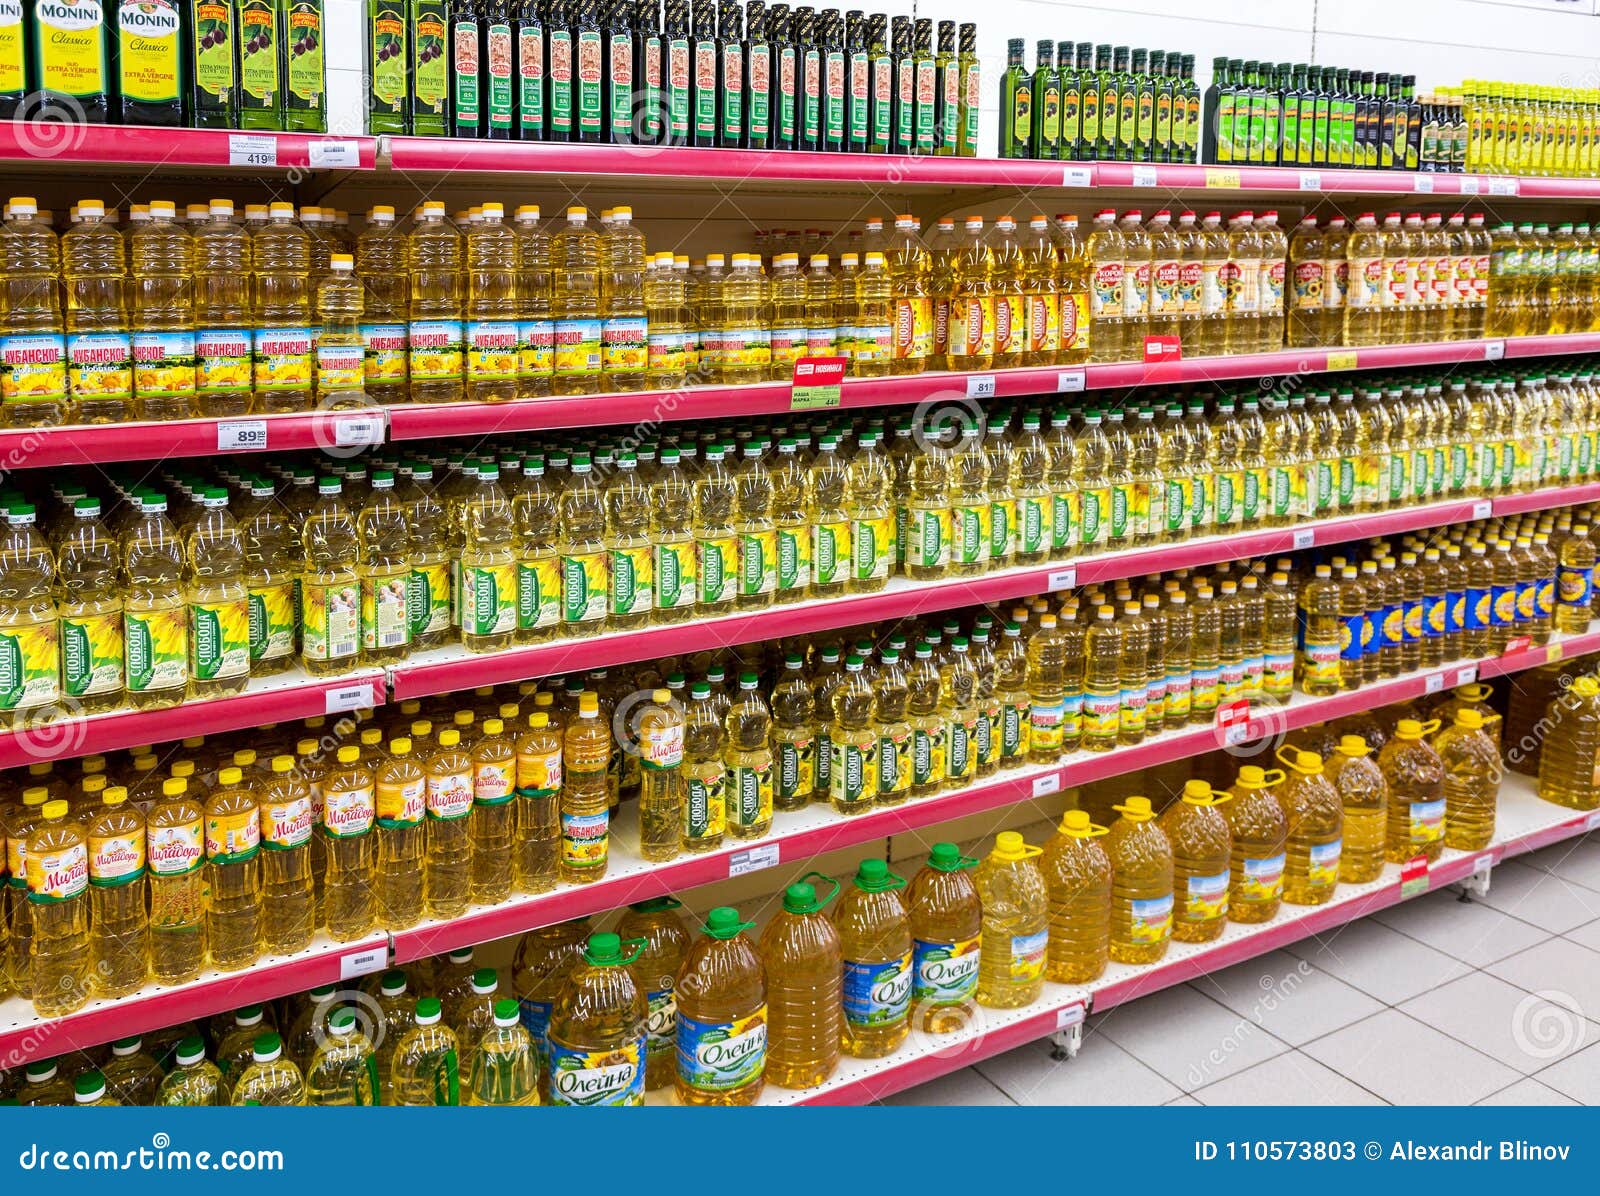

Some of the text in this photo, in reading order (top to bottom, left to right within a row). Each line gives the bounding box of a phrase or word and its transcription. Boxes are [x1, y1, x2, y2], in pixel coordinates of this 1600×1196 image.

[0, 4, 20, 17] INI
[41, 4, 98, 21] MONINI
[121, 12, 175, 28] MONINI
[51, 31, 91, 46] Classico
[130, 38, 168, 52] Classico
[69, 67, 98, 75] VERGINE
[125, 71, 174, 81] EXTRA VERGINE
[247, 154, 269, 164] 419
[370, 336, 405, 350] КУБАНС
[475, 334, 516, 347] КУБАНСКОЕ
[602, 329, 644, 342] КУБАНСКОЕ
[899, 305, 909, 346] СЛОБОДА
[5, 348, 60, 364] КУБАНСКОЕ
[73, 348, 125, 364] КУБАНСКОЕ
[198, 343, 247, 357] КУБАНСКОЕ
[262, 341, 308, 355] КУБАНСКОЕ
[815, 363, 842, 373] НОВИНКА
[977, 383, 988, 392] 81
[238, 430, 256, 442] 89
[925, 516, 935, 556] СЛОБОДА
[965, 513, 975, 553] СЛОБОДА
[993, 508, 1002, 547] СЛОБОДА
[1027, 504, 1037, 543] СЛОБОДА
[747, 540, 757, 584] СЛОБОДА
[781, 535, 791, 579] СЛОБОДА
[820, 530, 830, 573] СЛОБОДА
[859, 525, 869, 569] СЛОБОДА
[568, 564, 579, 610] СЛОБОДА
[617, 558, 628, 602] СЛОБОДА
[662, 552, 673, 596] СЛОБОДА
[706, 548, 717, 592] СЛОБОДА
[412, 575, 422, 622] СЛОБОДА
[478, 575, 489, 623] СЛОБОДА
[521, 570, 531, 617] СЛОБОДА
[67, 628, 80, 682] СЛОБОДА
[130, 623, 141, 677] СЛОБОДА
[198, 613, 211, 666] СЛОБОДА
[953, 728, 963, 767] СЛОБОДА
[1005, 709, 1015, 747] СЛОБОДА
[650, 740, 684, 760] Милад
[783, 748, 793, 787] СЛОБОДА
[819, 740, 829, 779] СЛОБОДА
[882, 742, 892, 782] СЛОБОДА
[916, 735, 926, 774] СЛОБОДА
[847, 750, 857, 791] СЛОБОДА
[691, 784, 702, 827] СЛОБОДА
[743, 773, 753, 814] СЛОБОДА
[273, 815, 312, 840] Милад
[327, 804, 375, 827] Миладор
[44, 860, 88, 892] Милад
[95, 850, 138, 867] Миладора
[559, 1065, 632, 1093] Олейна
